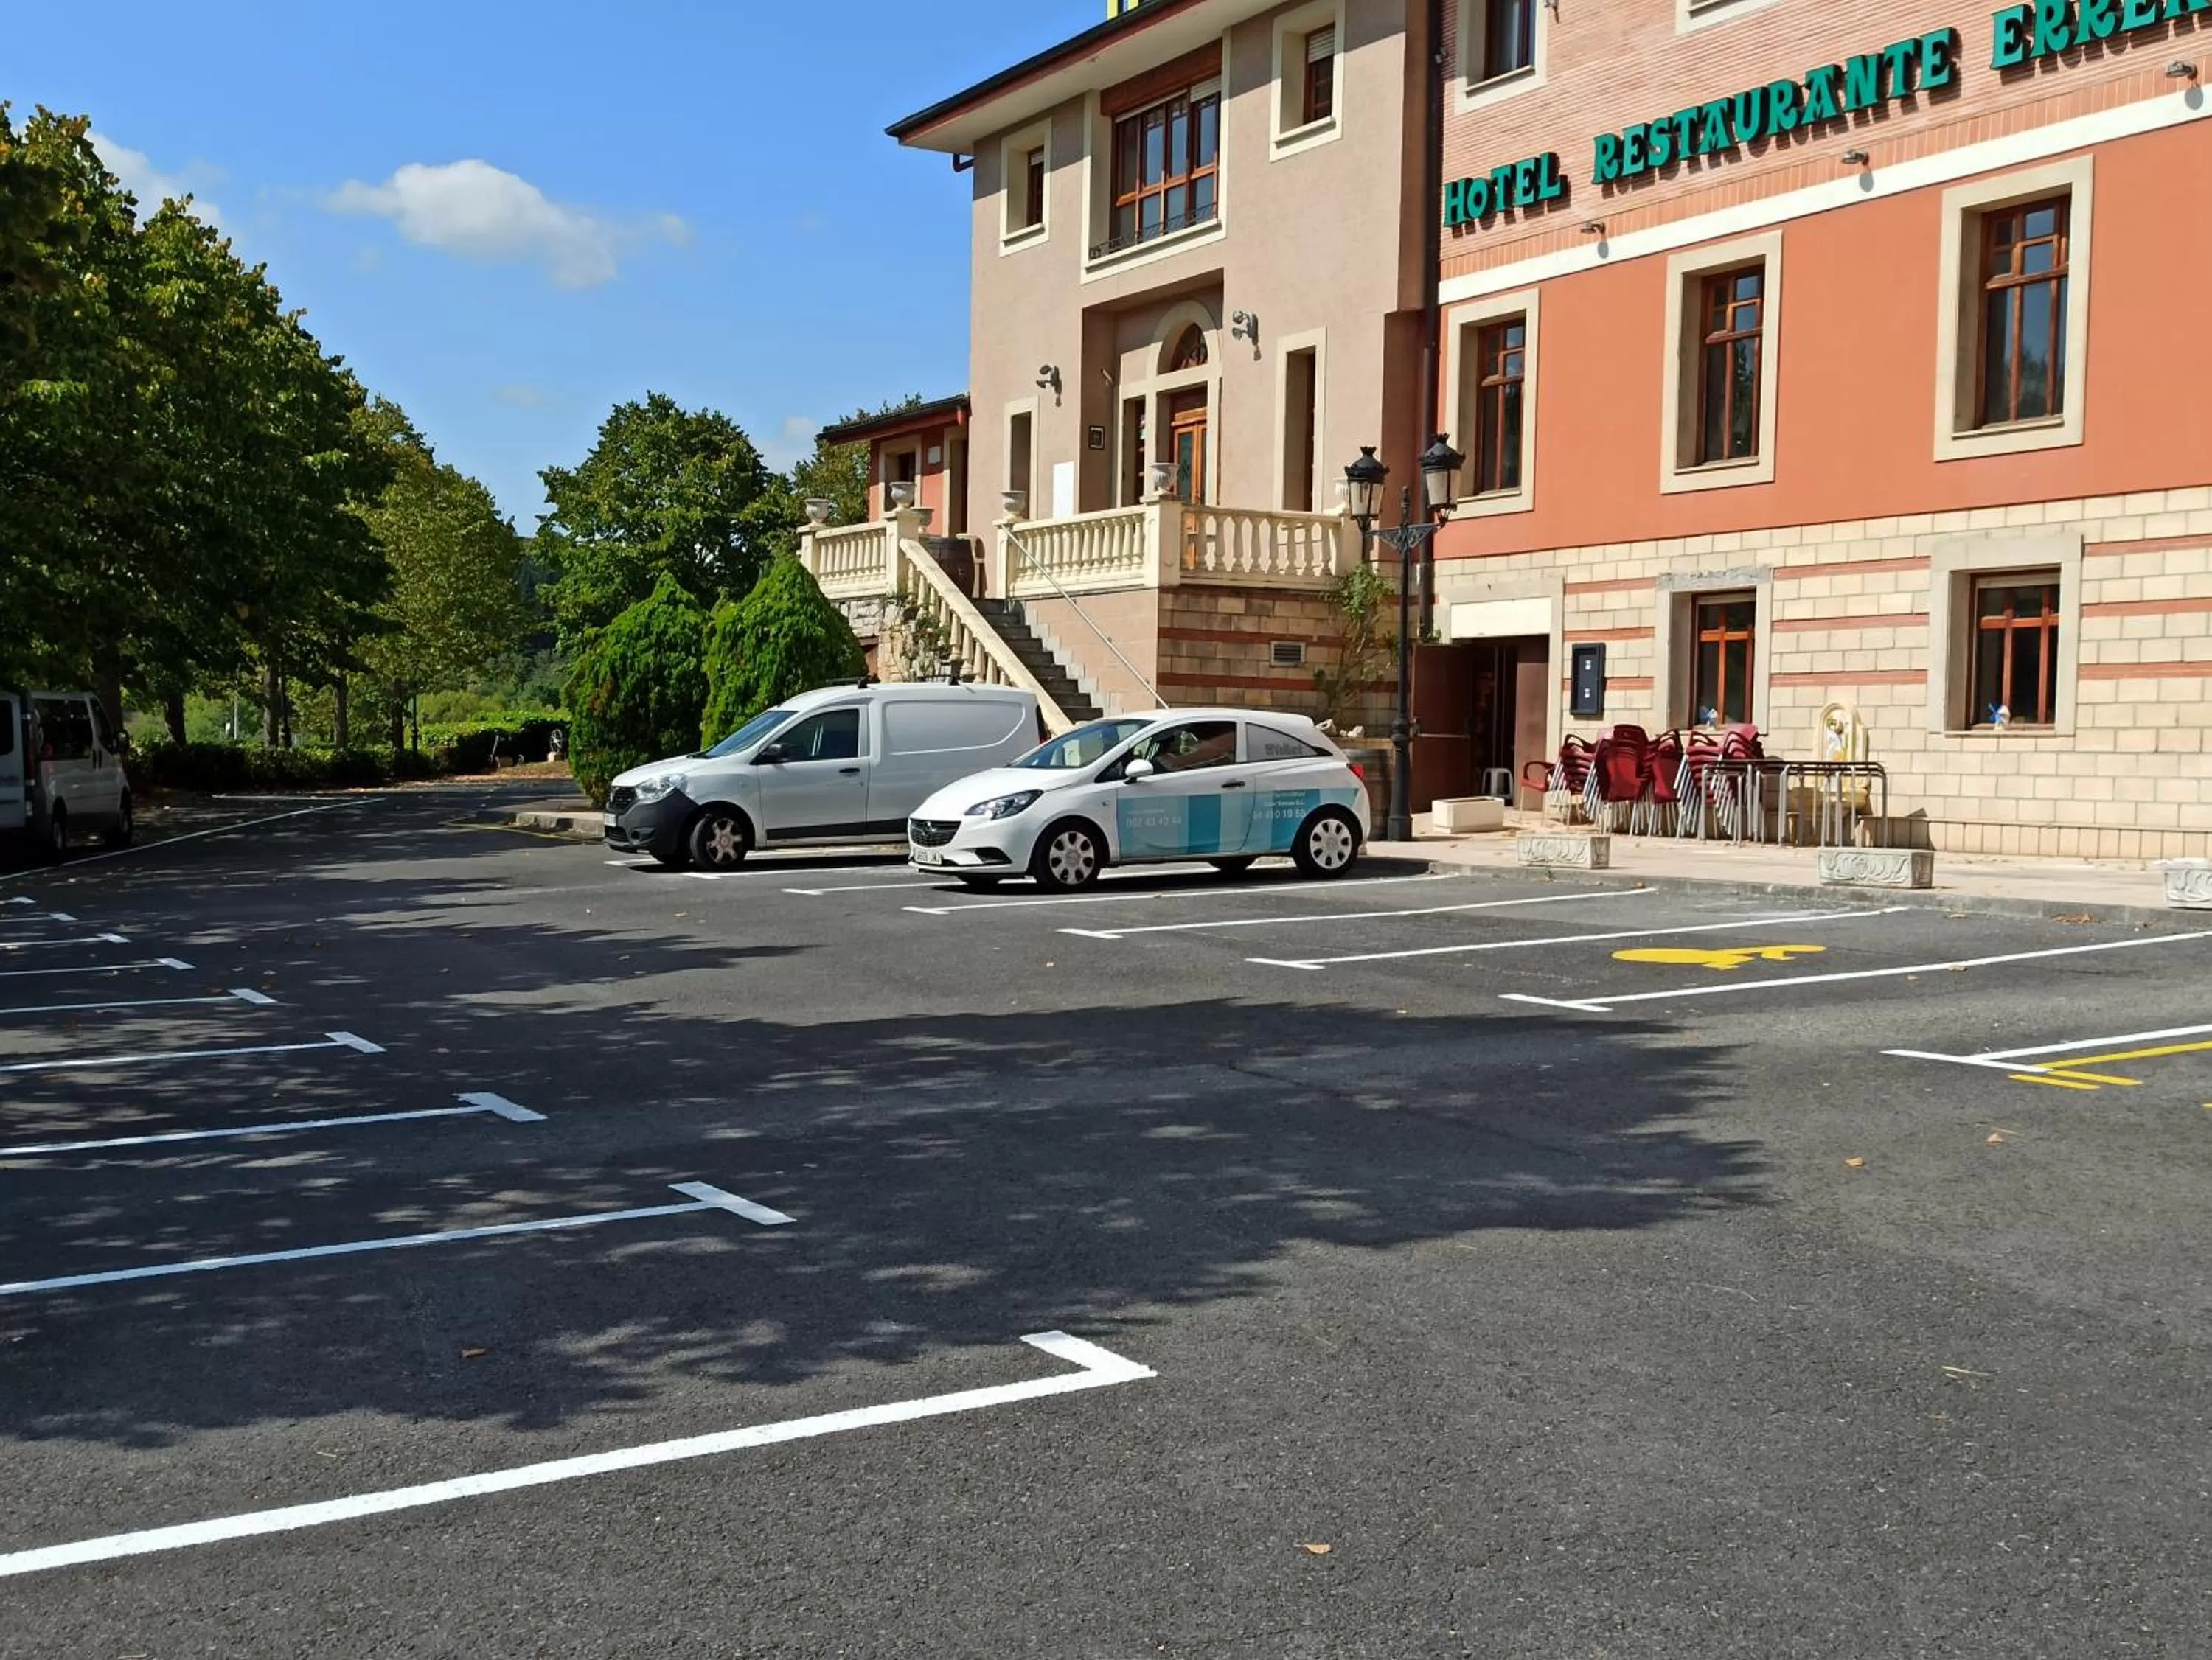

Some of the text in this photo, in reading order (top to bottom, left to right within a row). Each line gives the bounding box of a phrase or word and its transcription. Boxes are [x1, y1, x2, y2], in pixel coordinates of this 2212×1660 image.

[1444, 0, 2212, 227] HOTEL RESTAURANTE ERRE
